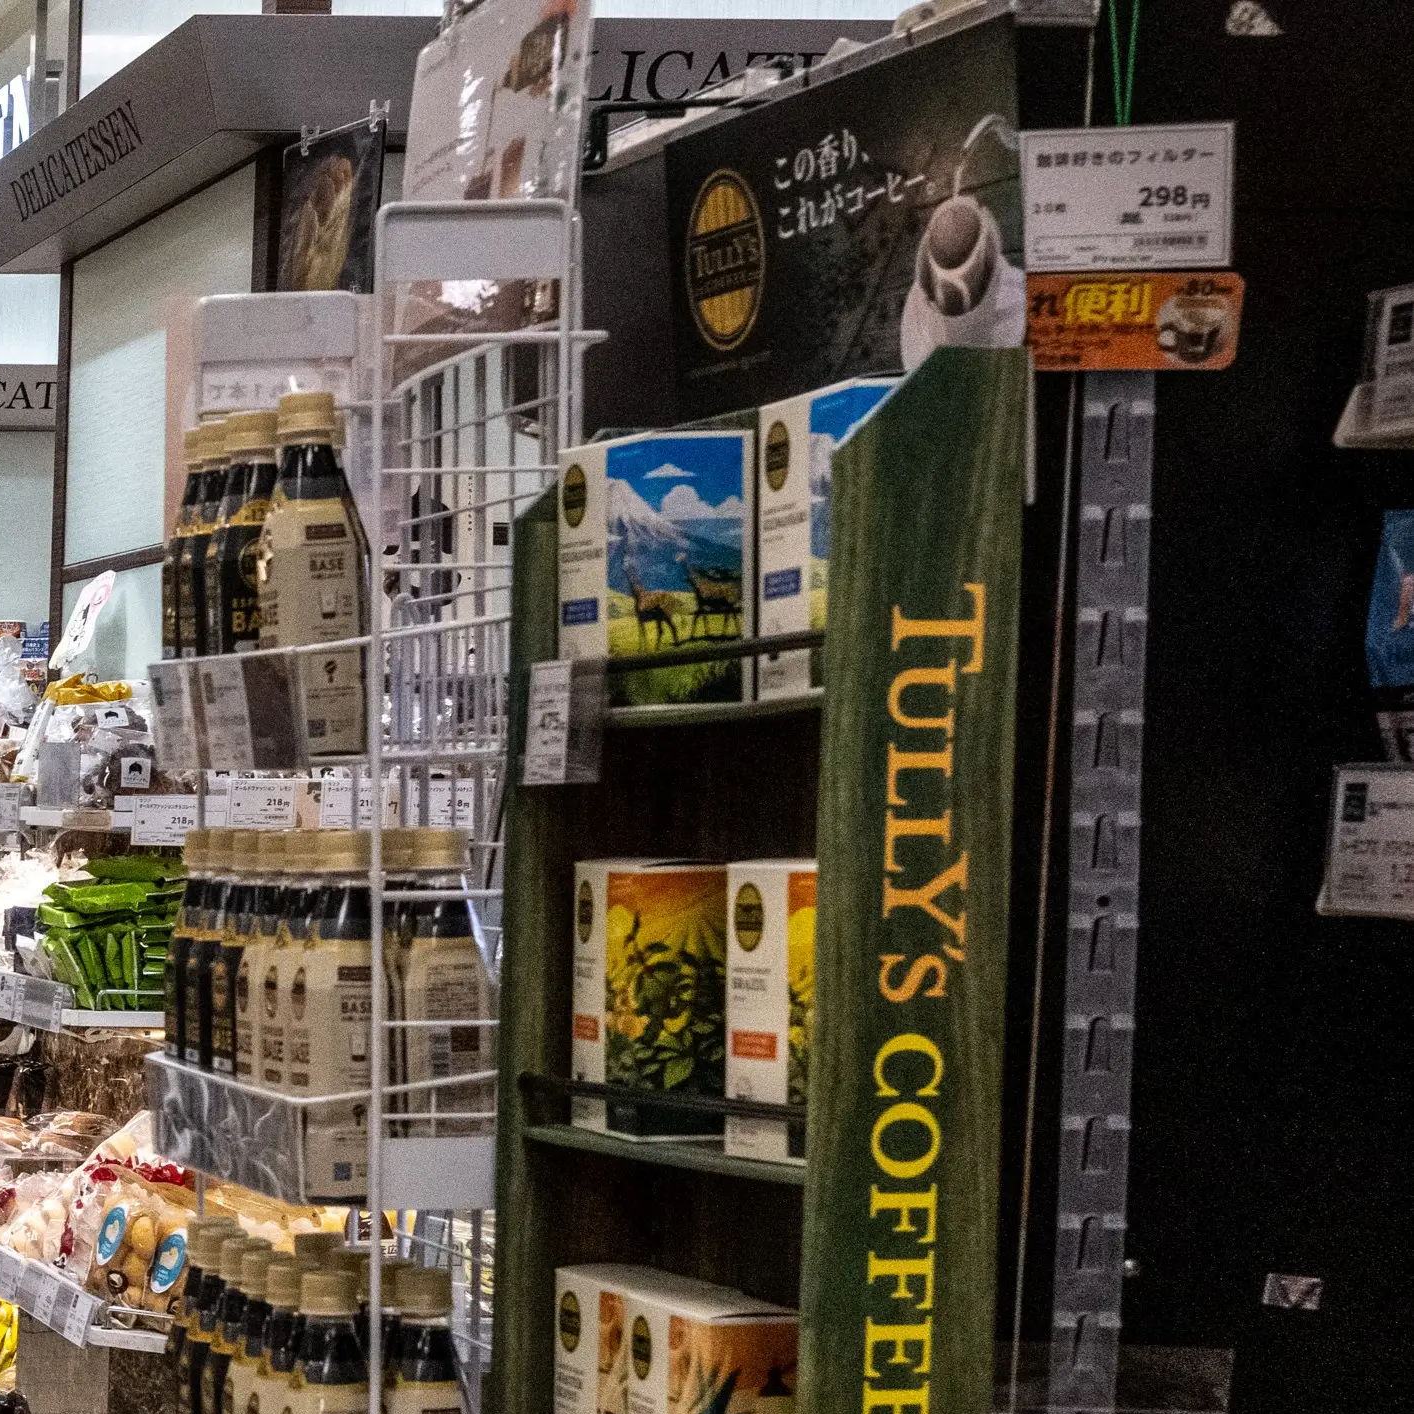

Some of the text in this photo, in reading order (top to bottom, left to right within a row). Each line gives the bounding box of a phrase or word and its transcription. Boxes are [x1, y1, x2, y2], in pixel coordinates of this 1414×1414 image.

[9, 100, 143, 222] DELICATESSEN
[774, 128, 869, 190] この香り、
[777, 171, 937, 239] これがコーヒー。
[171, 816, 194, 826] 218円
[878, 583, 985, 1004] TULLY'S
